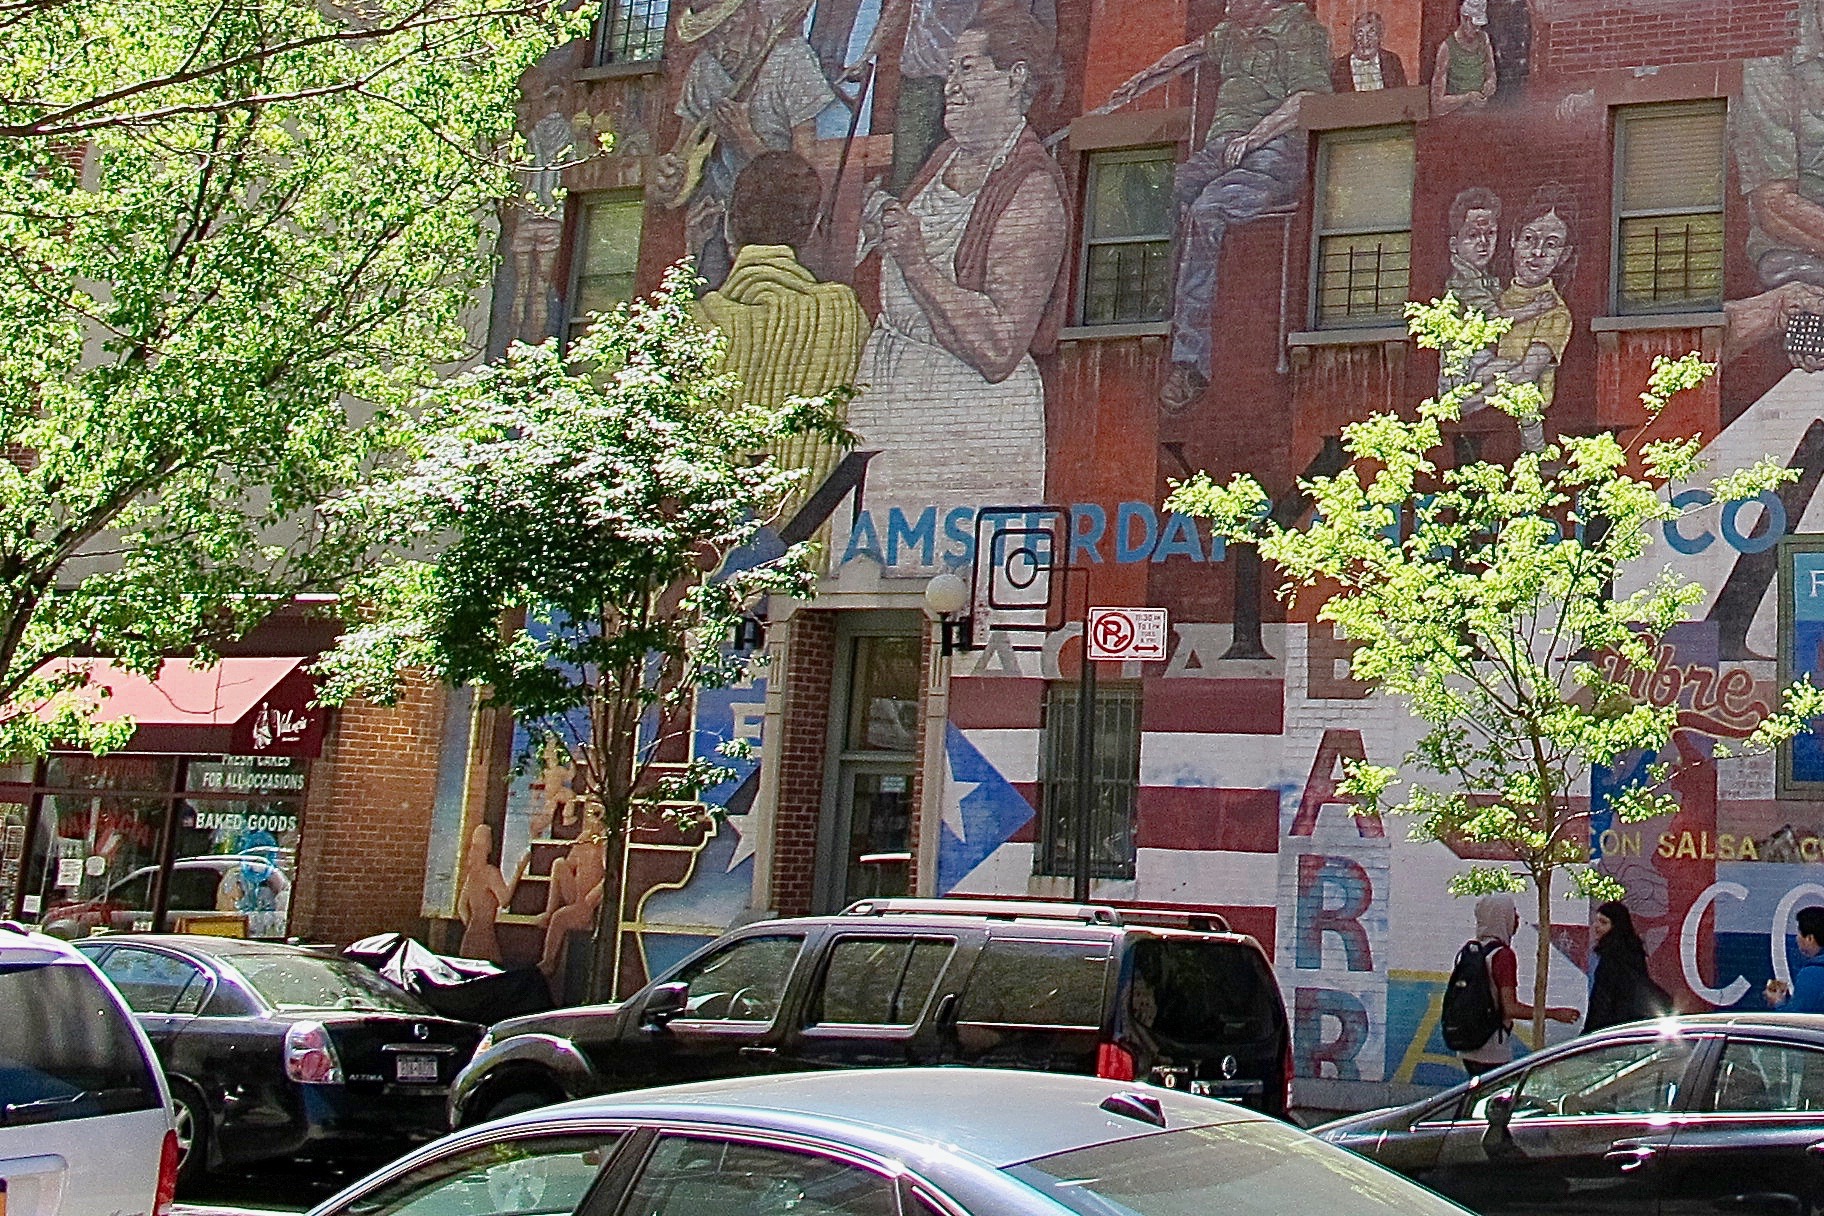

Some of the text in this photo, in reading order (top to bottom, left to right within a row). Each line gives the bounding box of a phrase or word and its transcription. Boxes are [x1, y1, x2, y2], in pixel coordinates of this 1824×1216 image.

[202, 772, 305, 790] FOR ALL OCCASIONS
[195, 813, 298, 832] BAKED GOODS
[1657, 830, 1760, 861] SALSA
